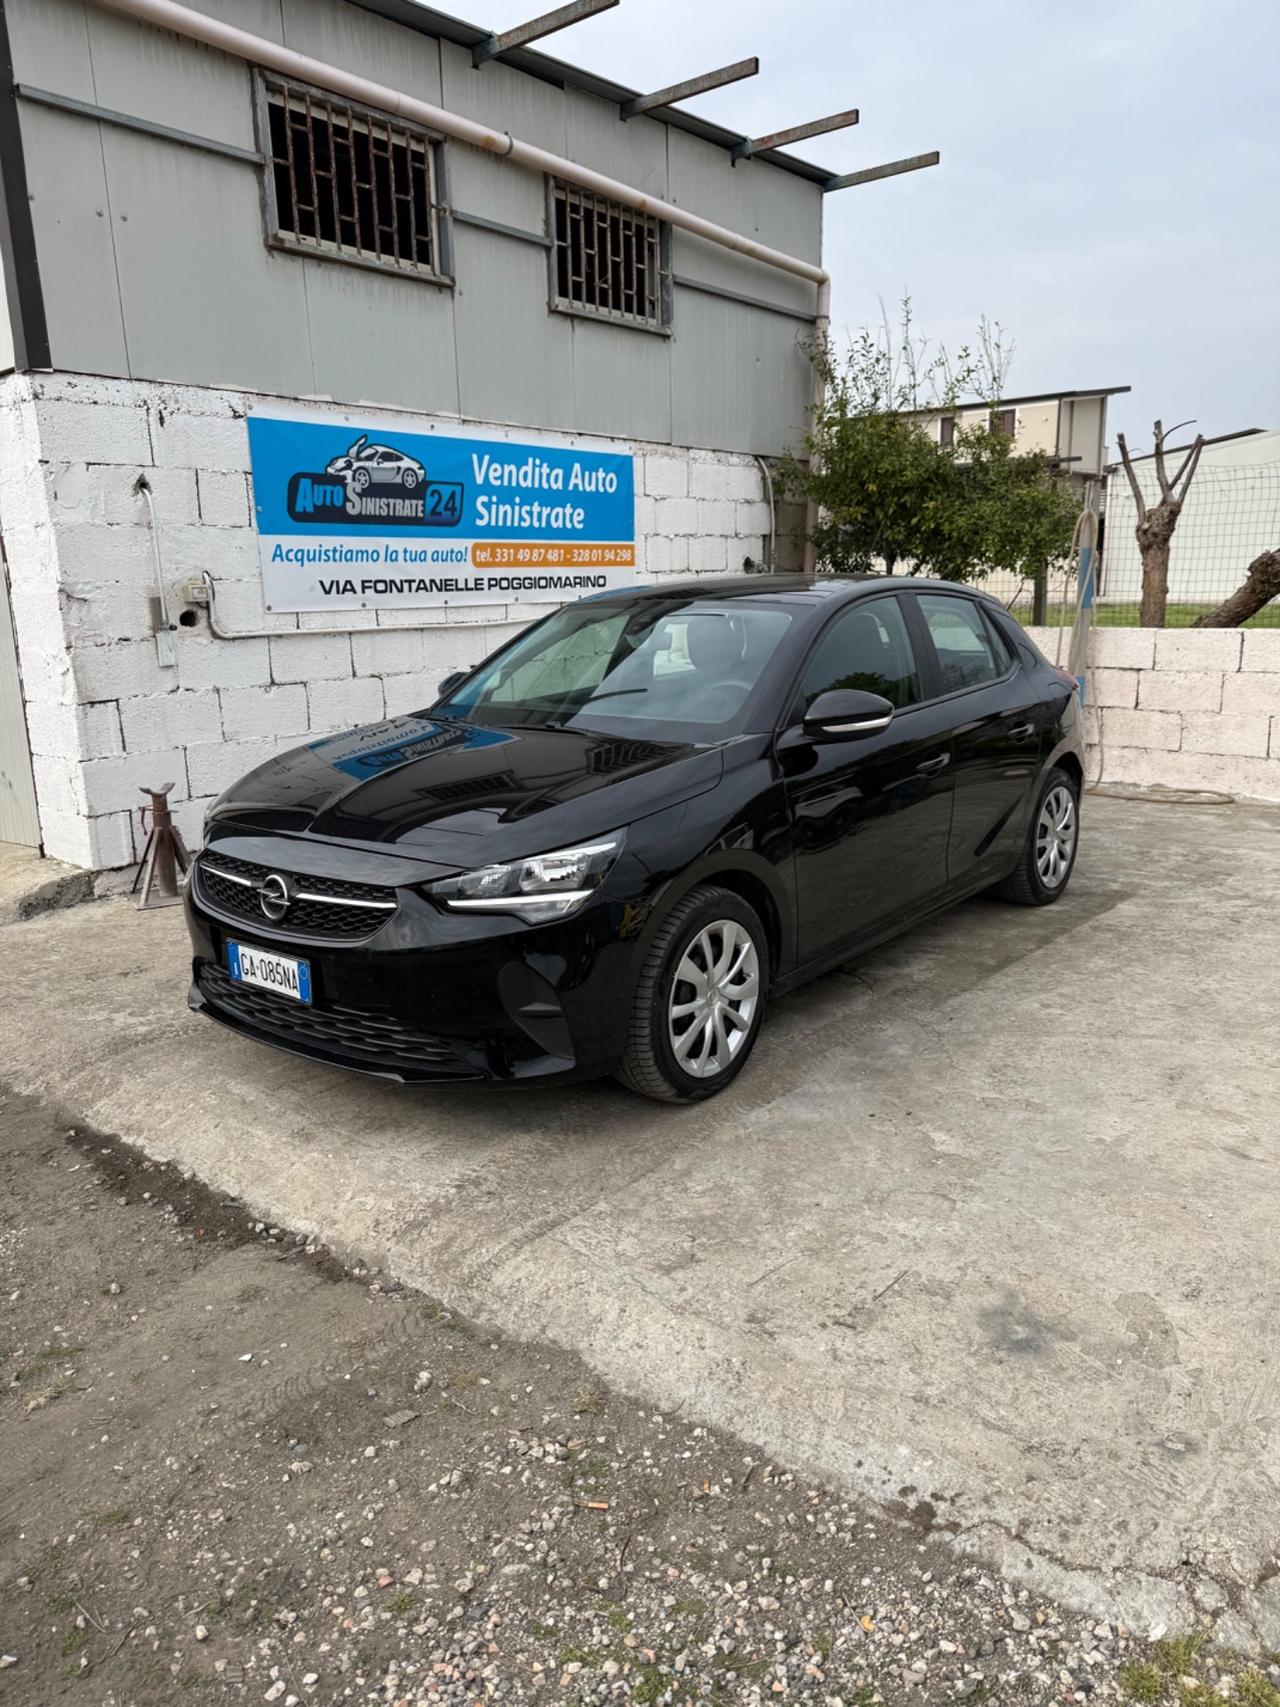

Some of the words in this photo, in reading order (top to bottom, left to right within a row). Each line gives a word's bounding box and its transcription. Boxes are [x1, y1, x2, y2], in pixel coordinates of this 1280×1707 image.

[471, 453, 564, 490] Vendita
[568, 462, 618, 493] Auto
[429, 488, 457, 517] 24
[475, 495, 585, 529] Sinistrate
[271, 543, 380, 567] Acquistiamo
[384, 544, 399, 563] la
[403, 547, 427, 563] tua
[431, 546, 468, 563] auto!
[476, 547, 493, 562] tel.
[495, 548, 514, 562] 331
[546, 549, 564, 562] 481
[572, 549, 590, 562] 328
[318, 580, 357, 595] VIA
[361, 578, 484, 594] FONTANELLE
[487, 575, 607, 591] POGGIOMARINO
